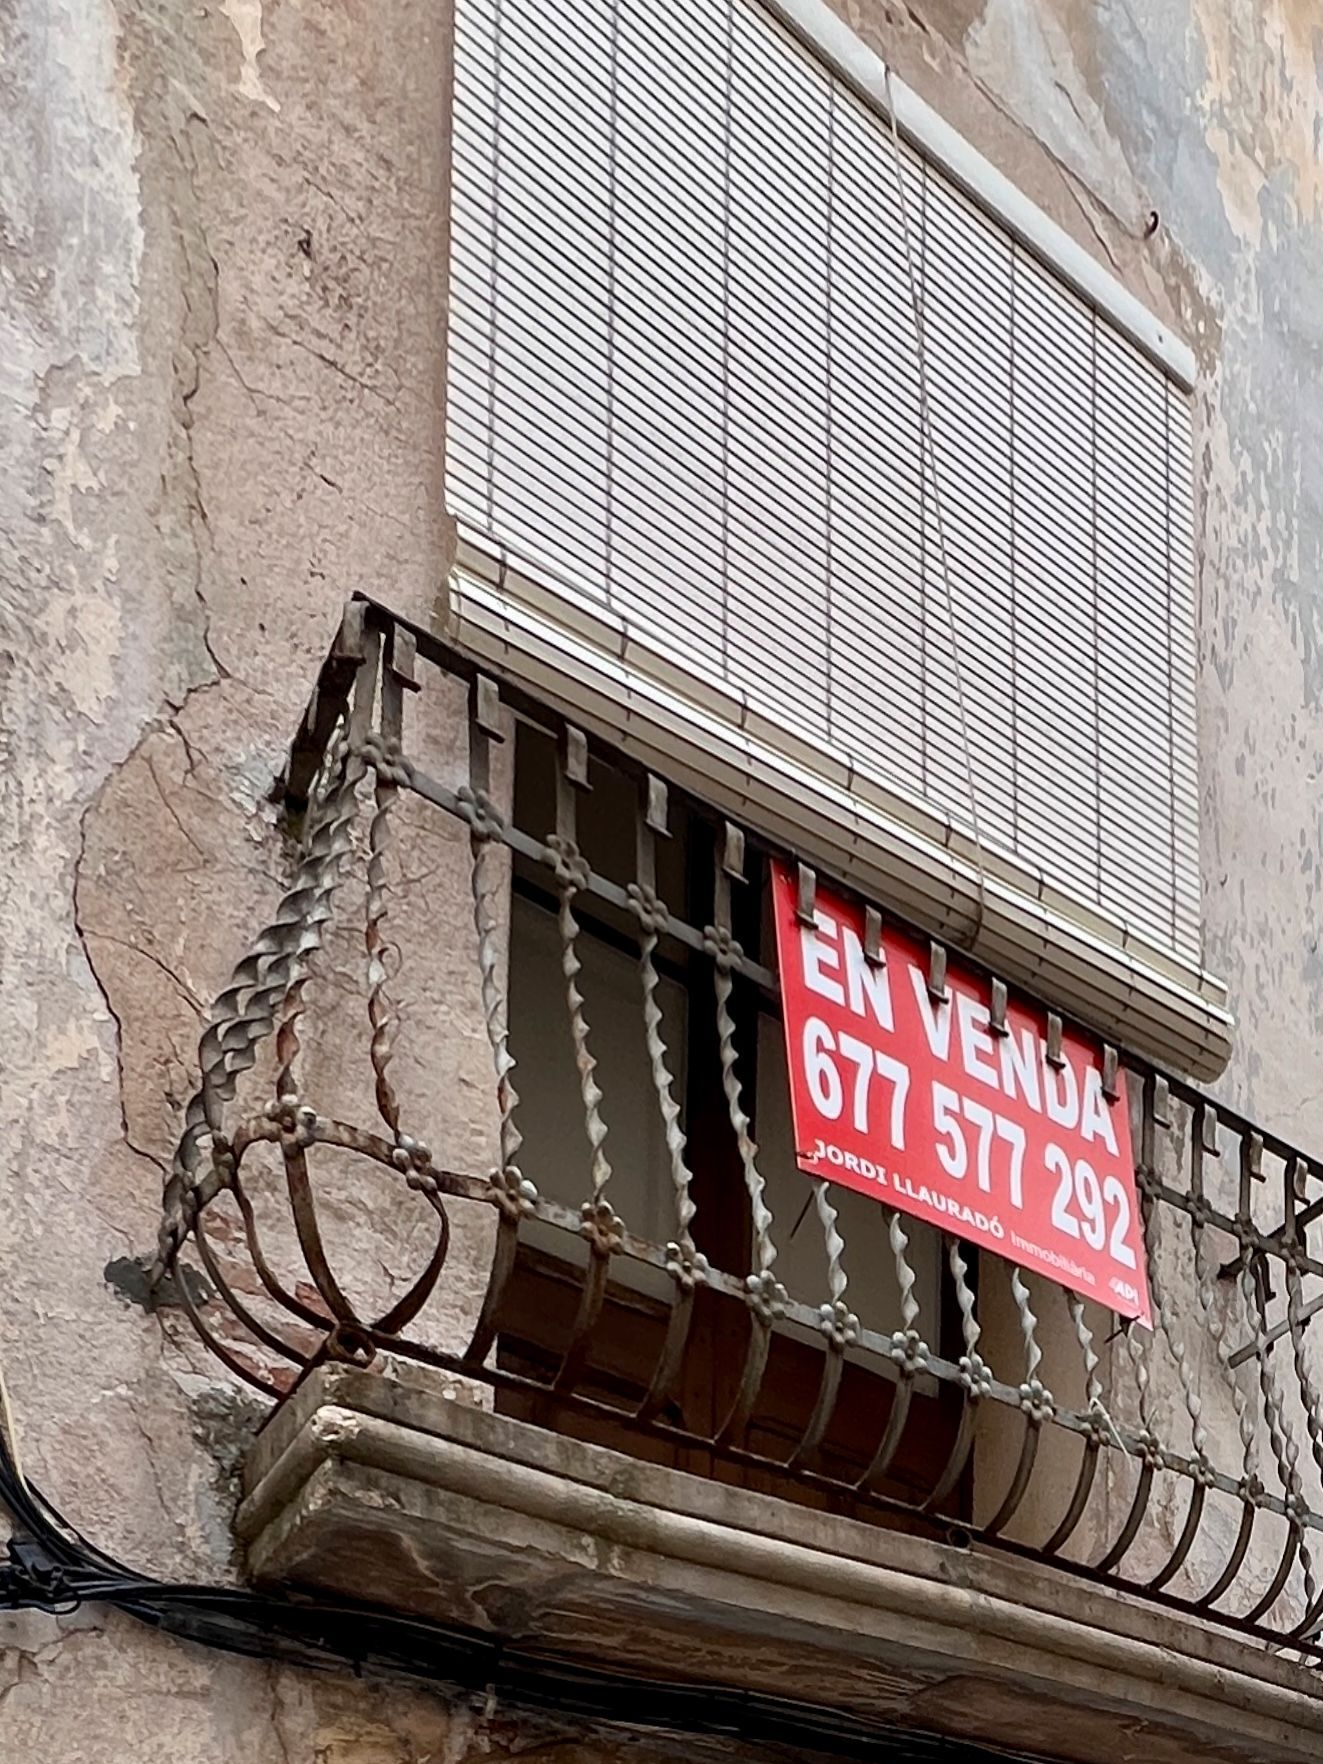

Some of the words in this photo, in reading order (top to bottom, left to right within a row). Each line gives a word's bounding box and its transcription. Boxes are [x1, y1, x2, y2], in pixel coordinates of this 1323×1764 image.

[799, 912, 895, 1032] EN
[908, 965, 1120, 1156] VENDA
[802, 1016, 910, 1151] 677
[932, 1081, 1027, 1209] 577
[1045, 1143, 1136, 1268] 292
[811, 1139, 888, 1185] JORDI
[893, 1173, 1004, 1239] LLAURADÓ
